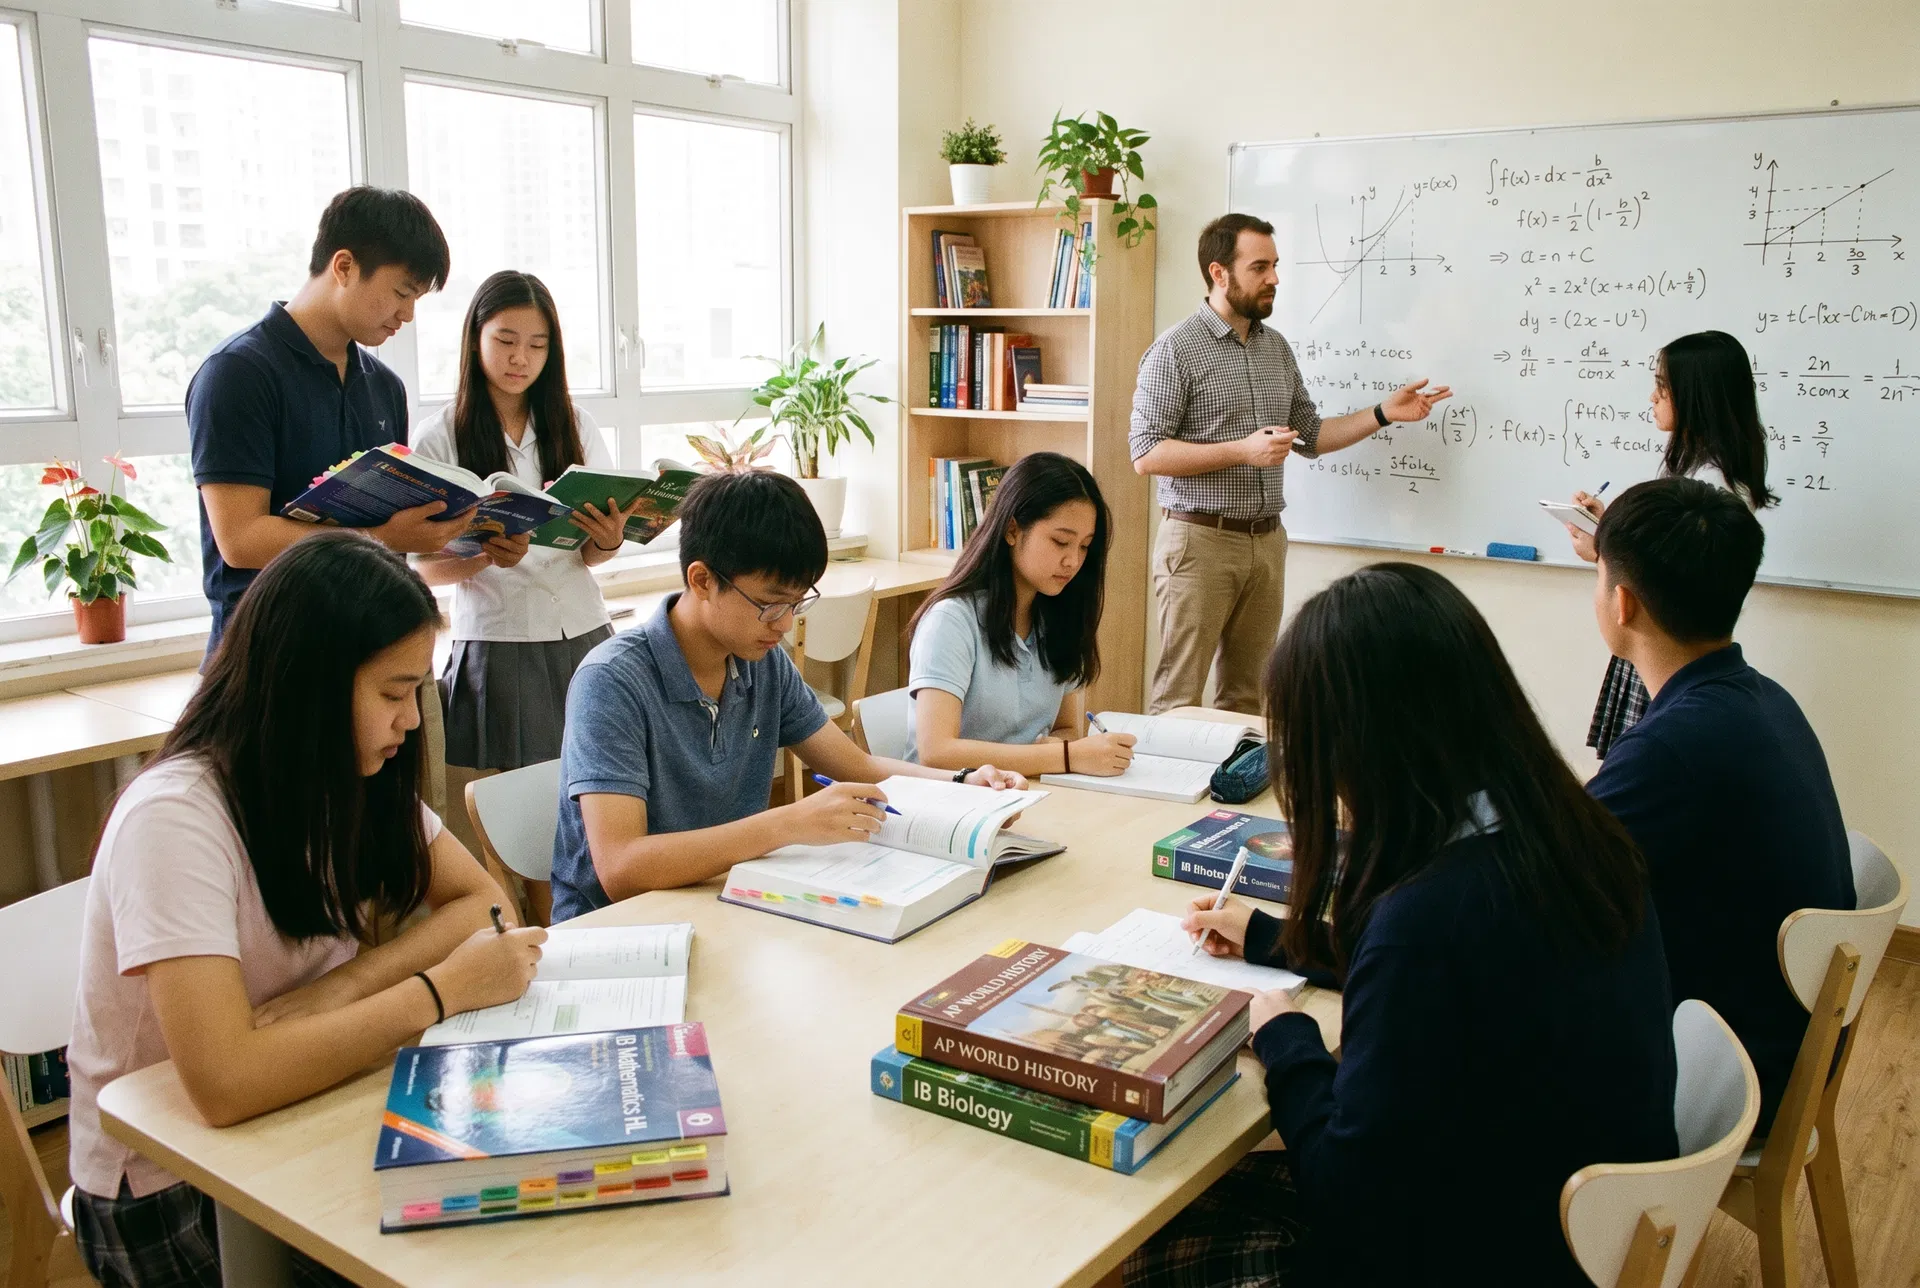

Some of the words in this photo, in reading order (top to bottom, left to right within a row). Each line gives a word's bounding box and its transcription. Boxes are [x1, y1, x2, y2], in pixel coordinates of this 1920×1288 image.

[1754, 153, 1762, 169] y
[1369, 186, 1375, 200] y
[1817, 252, 1826, 262] 2
[1894, 252, 1904, 260] x
[1380, 265, 1387, 275] 2
[1410, 265, 1416, 276] 3
[1786, 267, 1792, 277] 3
[1852, 264, 1859, 275] 3
[1520, 311, 1539, 334] dy
[1818, 421, 1828, 434] 3
[1454, 430, 1462, 442] 3
[1409, 482, 1419, 493] 2
[942, 1004, 962, 1018] AP
[961, 975, 1006, 1007] WORLD
[1001, 948, 1050, 982] HISTORY
[616, 1034, 636, 1046] IB
[934, 1036, 955, 1054] AP
[958, 1042, 1020, 1072] WORLD
[1025, 1060, 1098, 1094] HISTORY
[617, 1046, 645, 1116] Mathematics
[914, 1080, 932, 1101] IB
[938, 1087, 1013, 1131] Biology
[624, 1116, 648, 1135] HL
